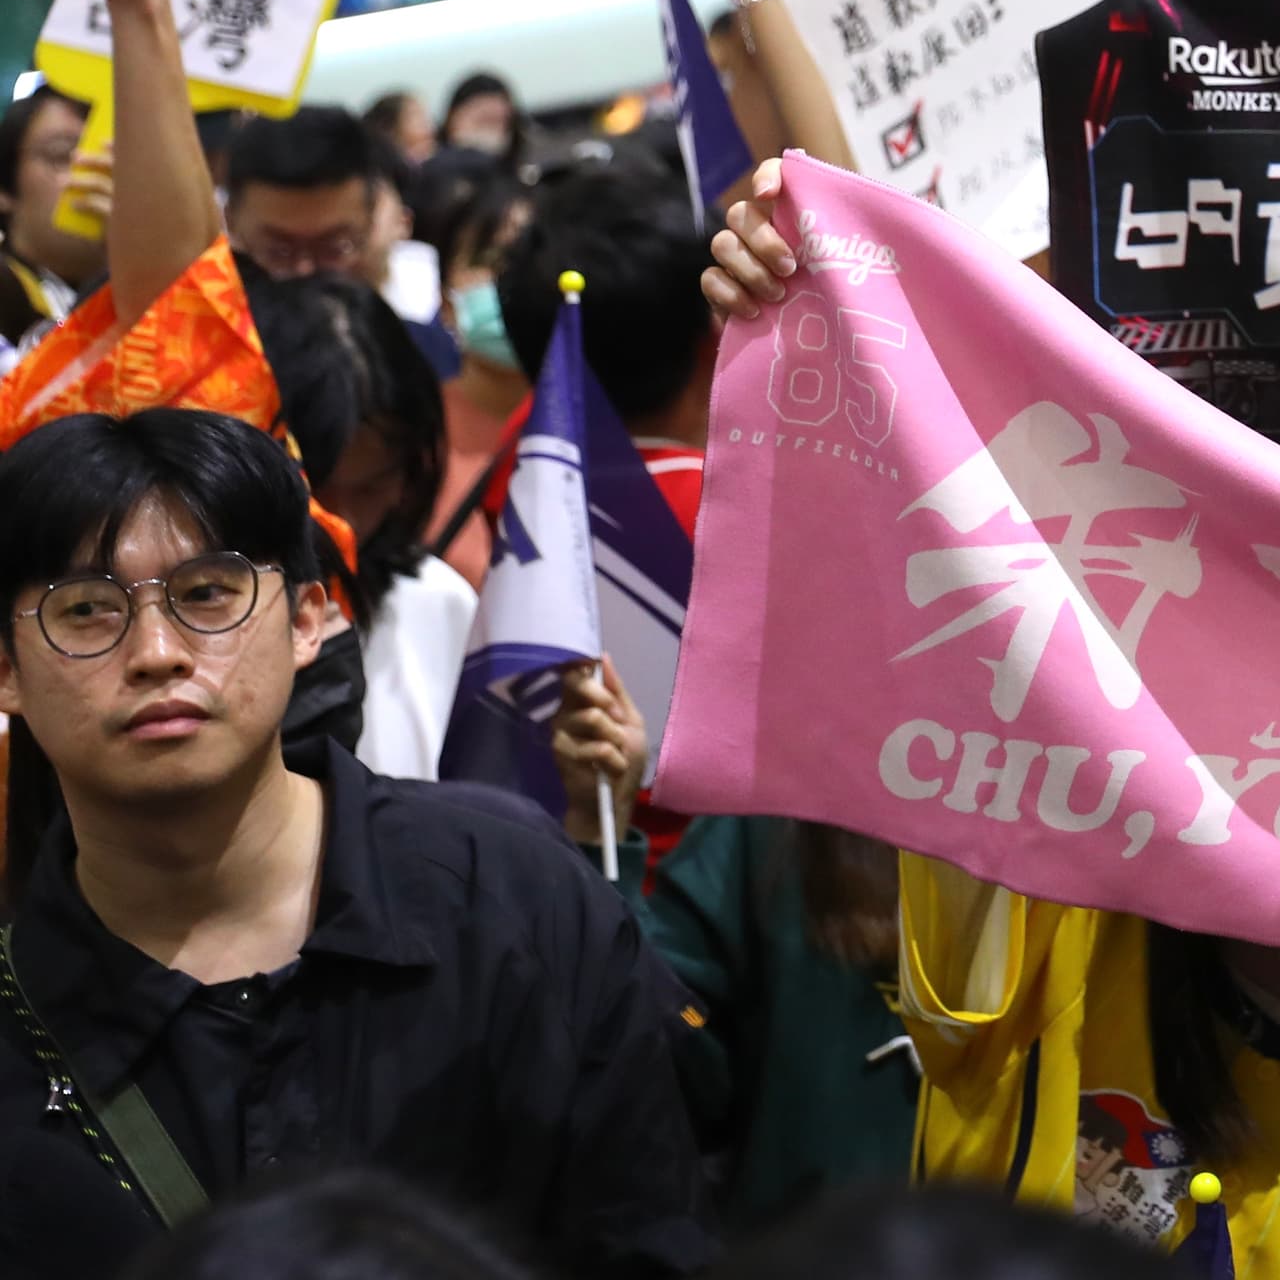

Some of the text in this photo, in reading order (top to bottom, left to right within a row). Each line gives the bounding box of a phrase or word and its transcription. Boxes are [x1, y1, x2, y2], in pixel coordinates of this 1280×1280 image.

[796, 208, 901, 286] Lamigo
[767, 290, 907, 448] 85
[878, 718, 1156, 859] CHU,
